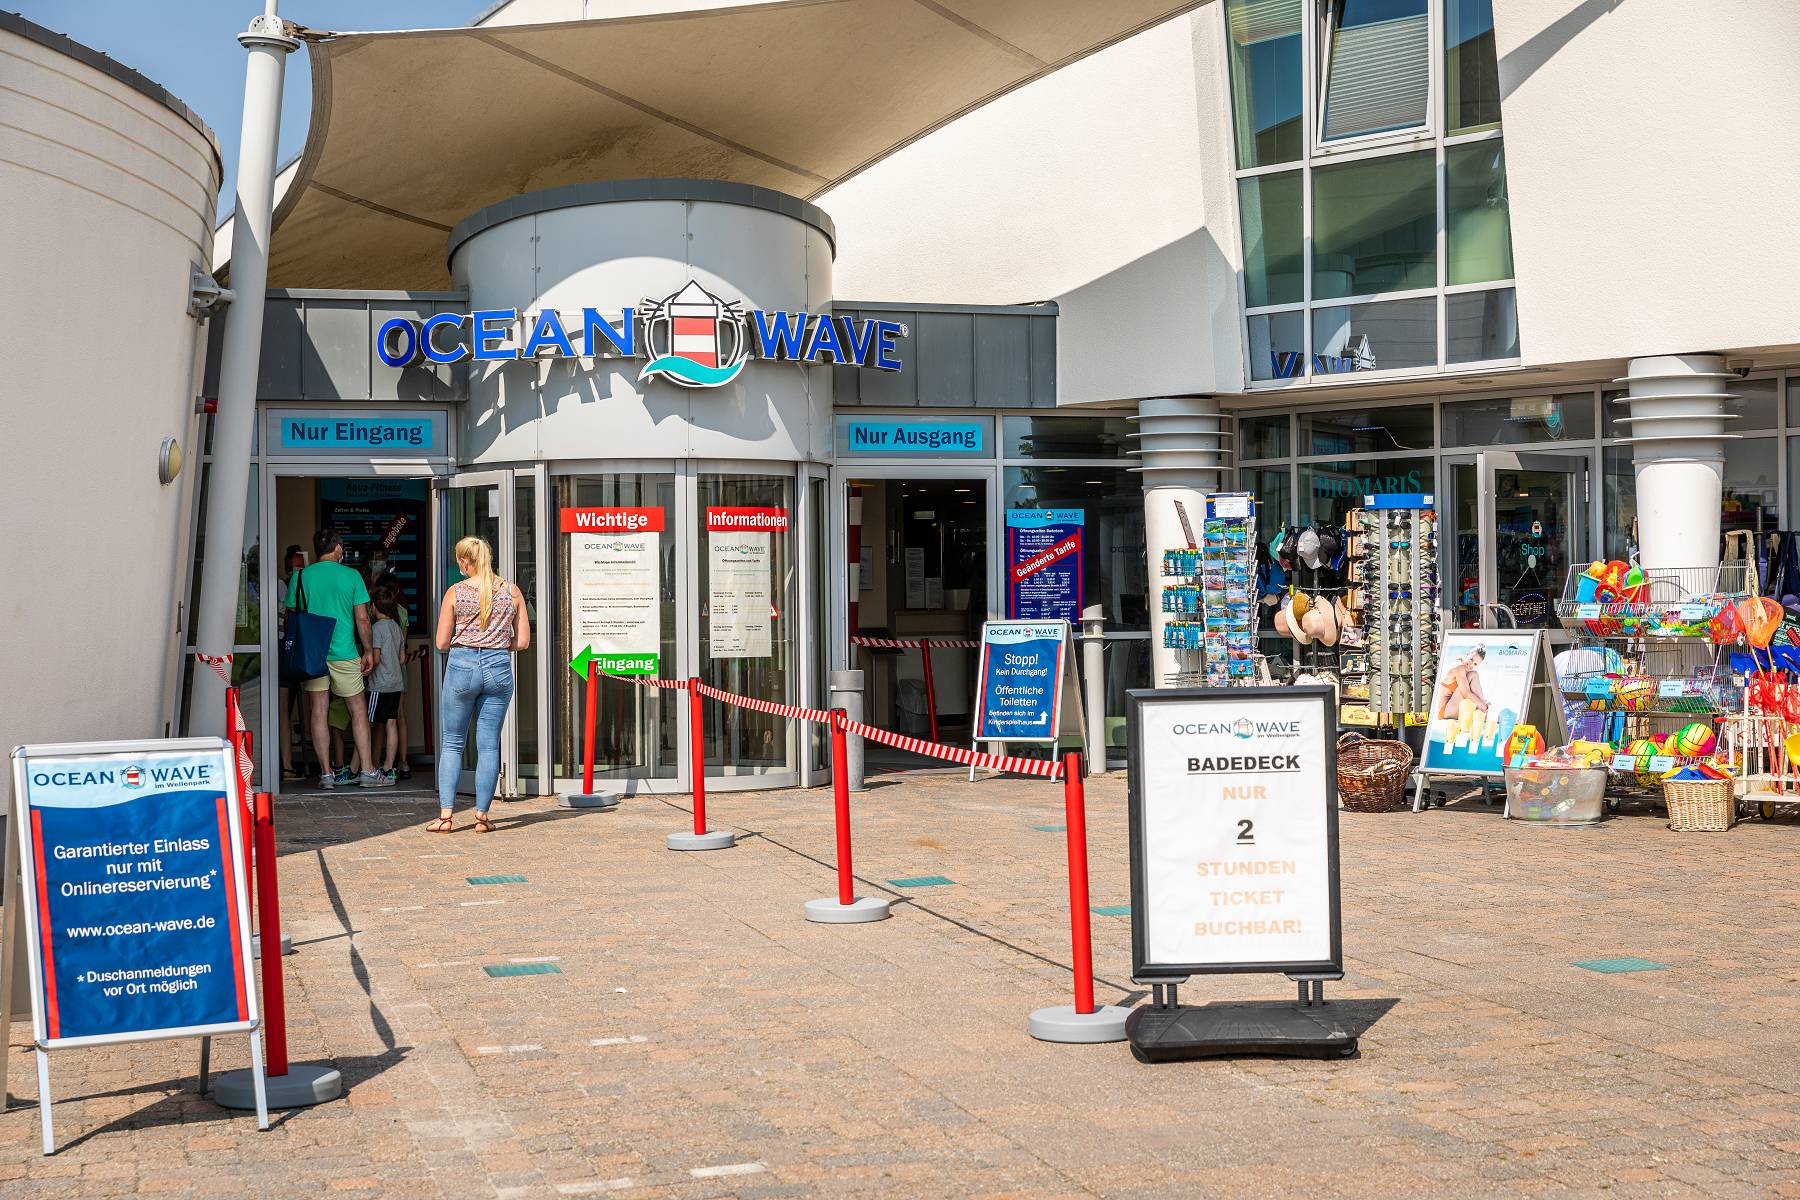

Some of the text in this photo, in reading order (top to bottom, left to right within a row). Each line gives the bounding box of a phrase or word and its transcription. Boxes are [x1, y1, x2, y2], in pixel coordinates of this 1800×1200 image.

[377, 306, 903, 372] OCEAN WAVE
[291, 422, 423, 445] Nur Eingang
[855, 427, 976, 448] Nur Ausgang
[576, 511, 648, 528] Wichtige
[708, 511, 788, 527] Informationen
[1016, 552, 1054, 577] Geänderte
[1054, 541, 1076, 556] Tarife
[1521, 543, 1545, 559] Shop
[596, 657, 654, 671] Eingang
[1004, 653, 1038, 668] Stopp!
[995, 668, 1047, 677] Kein Durchgang!
[995, 685, 1043, 695] Öffentliche
[1000, 697, 1037, 707] Toiletten
[1173, 721, 1300, 735] OCEAN WAVE
[1187, 755, 1300, 772] BADEDECK
[34, 765, 210, 787] OCEAN WAVE
[166, 780, 211, 789] Wellenpark
[1222, 786, 1267, 800] NUR
[1237, 819, 1254, 840] 2
[54, 838, 210, 859] Garantierter Einlass
[106, 859, 163, 875] nur mit
[1196, 860, 1296, 877] STUNDEN
[1209, 890, 1285, 906] TICKET
[67, 915, 215, 938] www.ocean-wave.de
[1194, 919, 1303, 937] BUCHBAR!
[103, 979, 198, 997] vor Ort möglich
